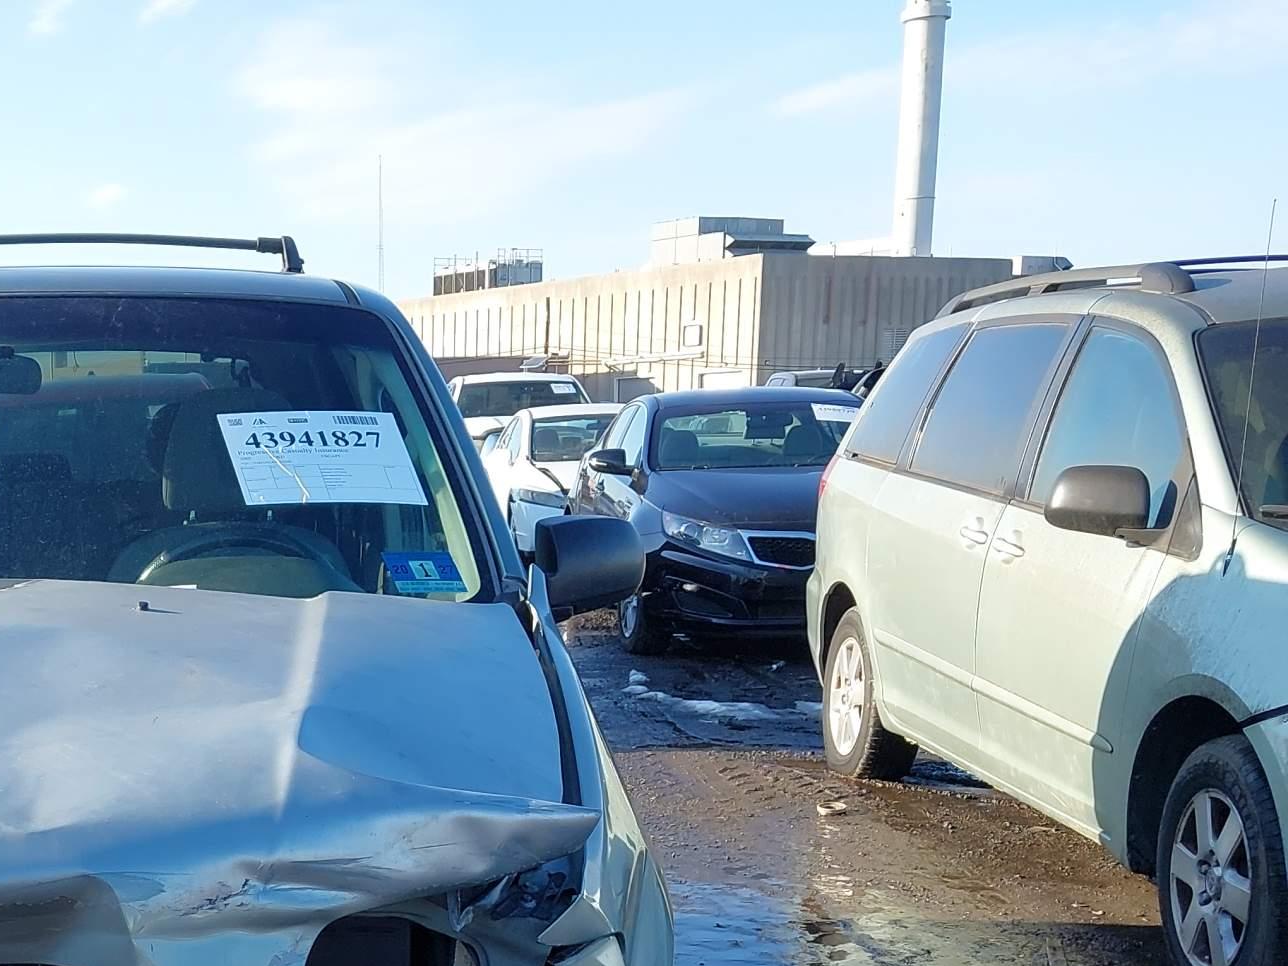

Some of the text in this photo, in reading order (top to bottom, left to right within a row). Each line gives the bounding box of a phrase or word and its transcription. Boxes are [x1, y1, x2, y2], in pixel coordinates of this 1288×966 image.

[245, 430, 381, 449] 43941827
[281, 447, 313, 456] Casualty
[418, 562, 433, 578] 1
